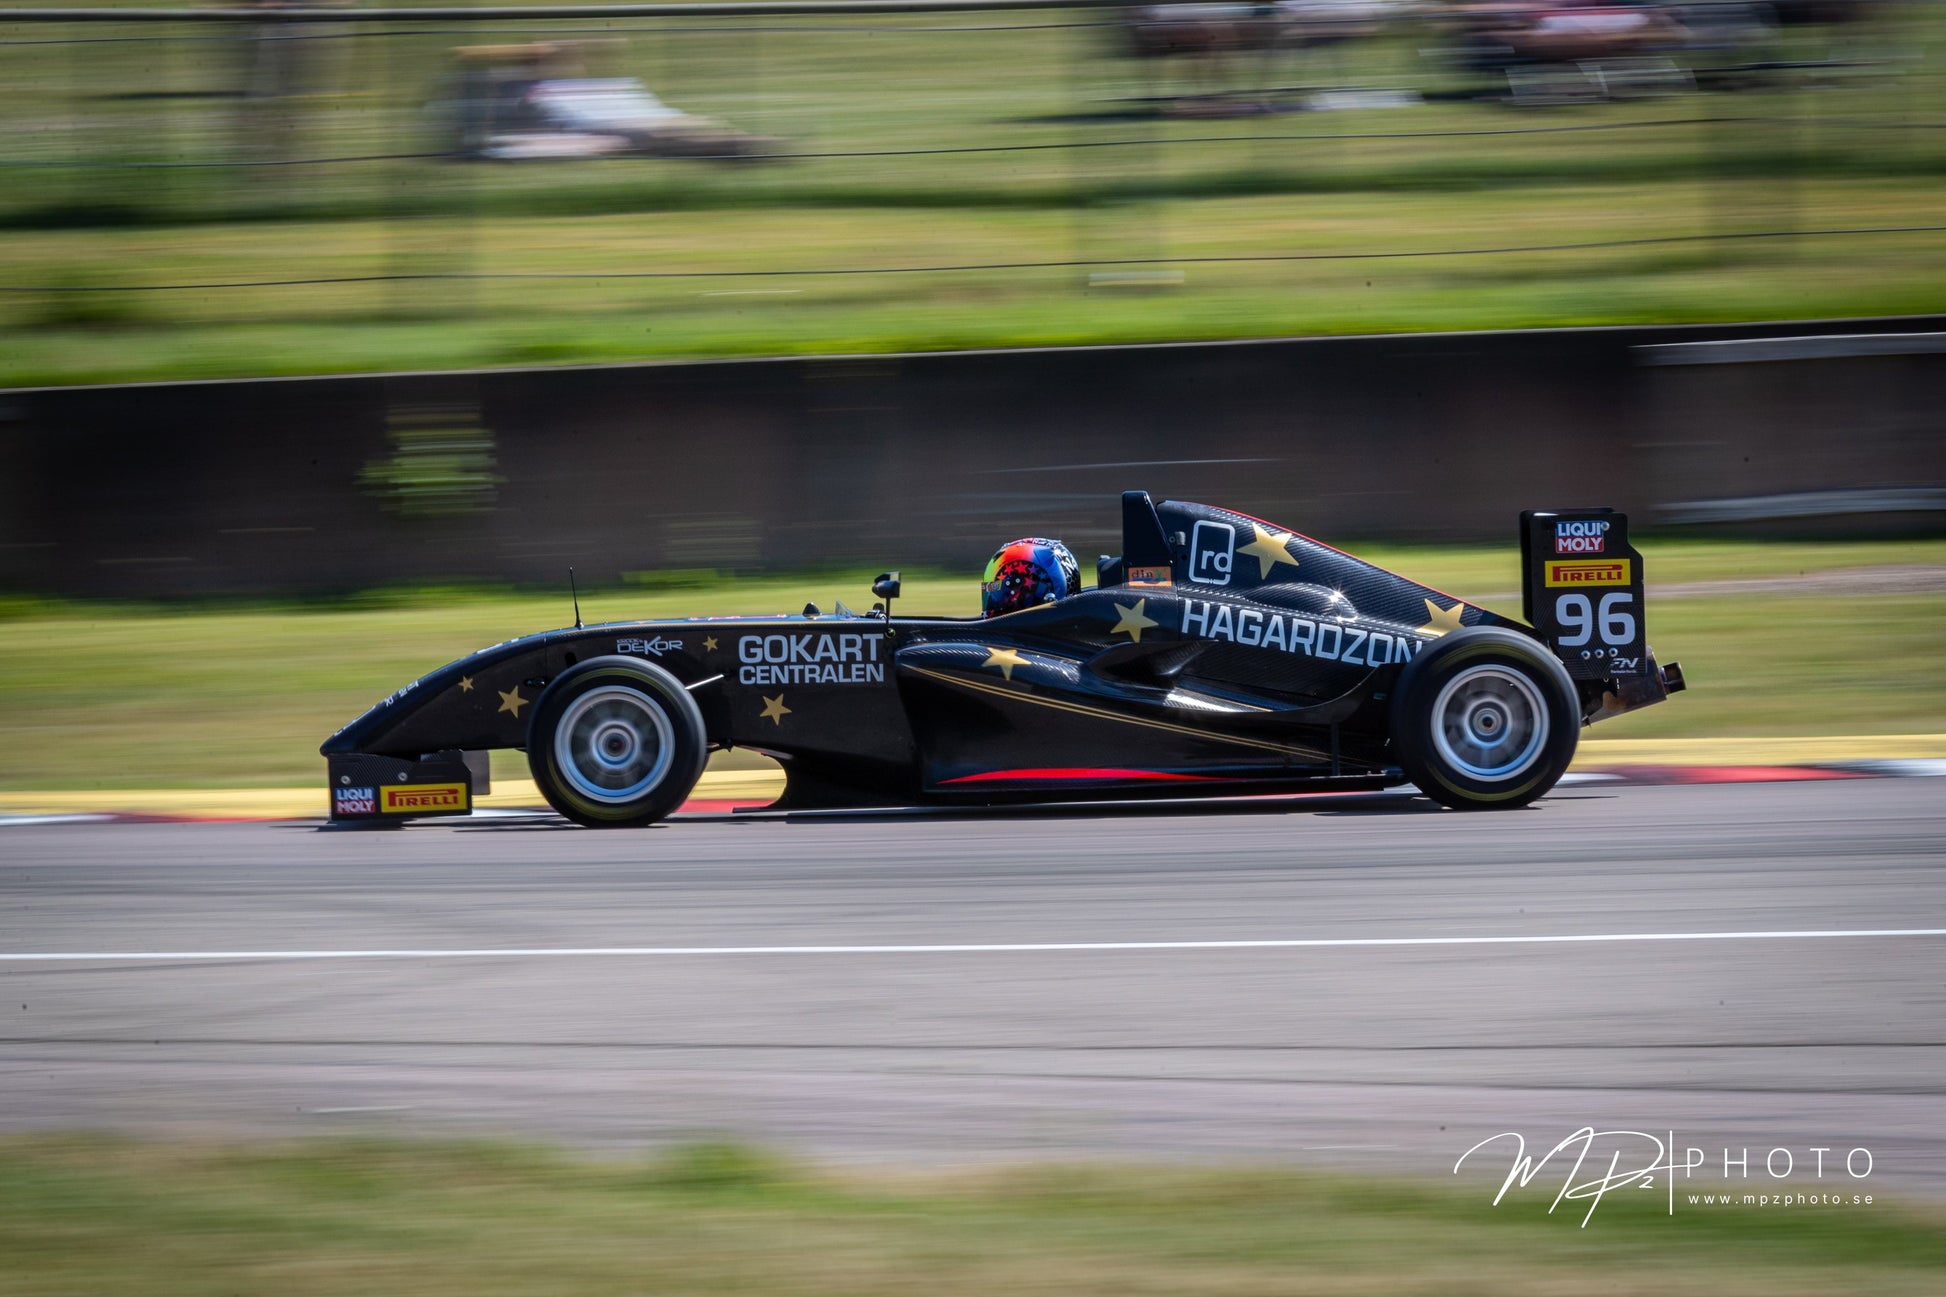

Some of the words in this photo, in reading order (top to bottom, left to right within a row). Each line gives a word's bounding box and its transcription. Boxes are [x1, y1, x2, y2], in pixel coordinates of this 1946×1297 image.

[1557, 522, 1601, 537] LIQUI
[1558, 537, 1602, 551] MOLY
[1552, 564, 1623, 582] PIRELLI
[1556, 593, 1636, 647] 96
[1181, 598, 1423, 667] HAGARDZON
[738, 633, 884, 664] GOKART
[739, 663, 884, 685] CENTRALEN
[336, 788, 374, 800] LIQUI
[388, 788, 459, 807] PIRELLI
[337, 800, 375, 813] MOLY
